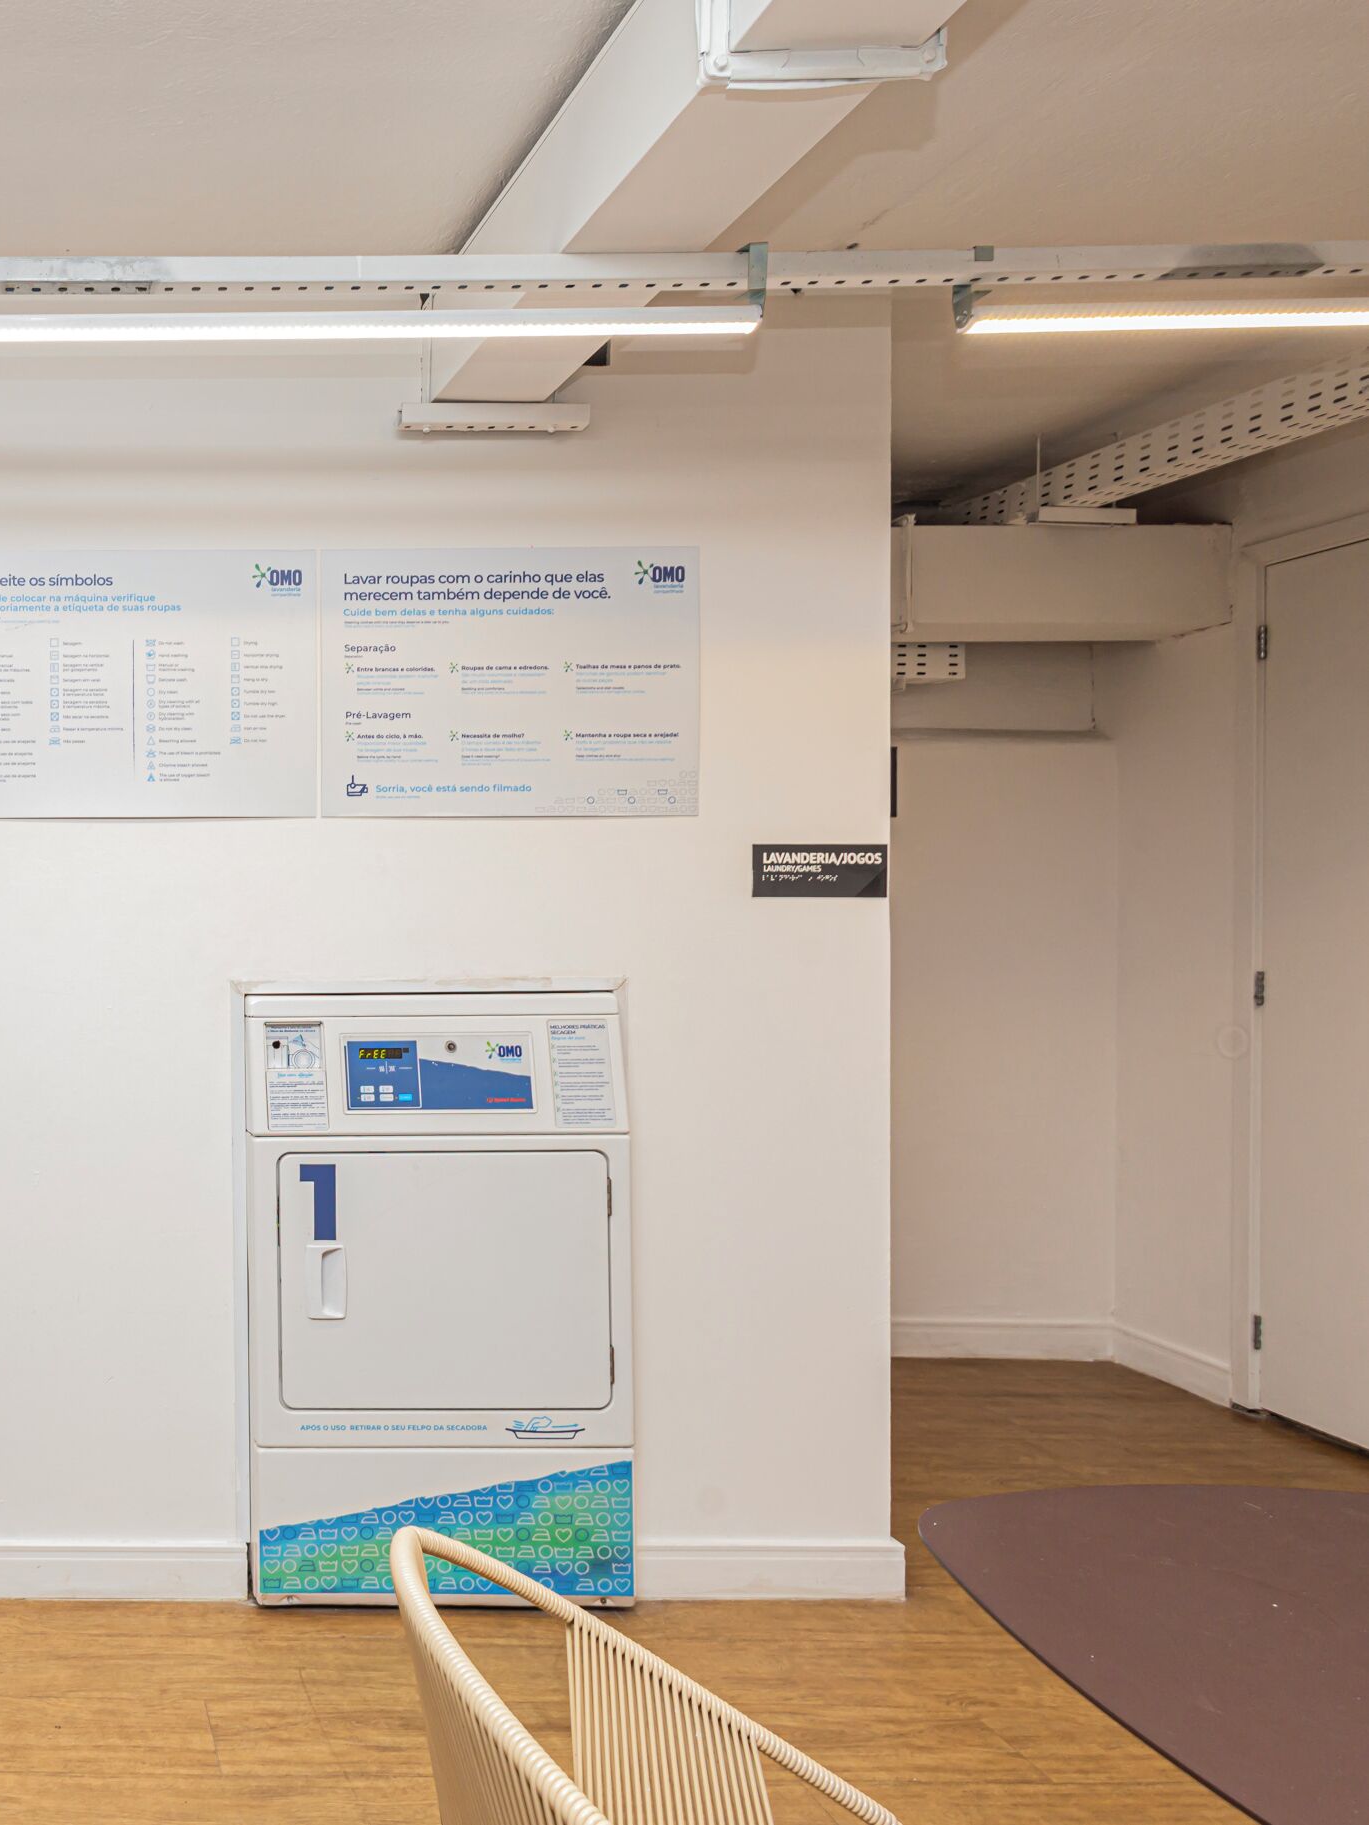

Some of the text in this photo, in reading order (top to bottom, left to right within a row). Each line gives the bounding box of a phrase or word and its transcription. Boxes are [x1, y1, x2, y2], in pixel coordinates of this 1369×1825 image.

[29, 577, 46, 587] os
[48, 574, 113, 587] símbolos
[270, 569, 302, 586] OMO
[344, 571, 605, 587] Lavar roupas com o carinho que elas
[652, 565, 685, 583] OMO
[10, 593, 45, 602] colocar
[64, 593, 108, 604] máquina
[111, 593, 155, 604] verifique
[344, 587, 611, 603] merecem também depende de você.
[62, 603, 104, 614] etiqueta
[106, 603, 119, 612] de
[147, 605, 181, 614] roupas
[343, 607, 372, 617] Cuide
[375, 607, 397, 616] bem
[400, 607, 427, 616] delas
[438, 607, 467, 616] tenha
[470, 607, 503, 618] alguns
[506, 607, 555, 616] cuidados:
[343, 644, 397, 654] Separação
[345, 710, 412, 721] Pré-Lavagem
[376, 783, 532, 794] Sorria, você está sendo filmado
[763, 852, 882, 865] LAVANDERIA/JOGOS
[498, 1045, 522, 1058] OMO
[299, 1164, 336, 1240] 1
[300, 1423, 487, 1432] APÓS O USO RETIRAR O SEU FELPO DA SECADORA
